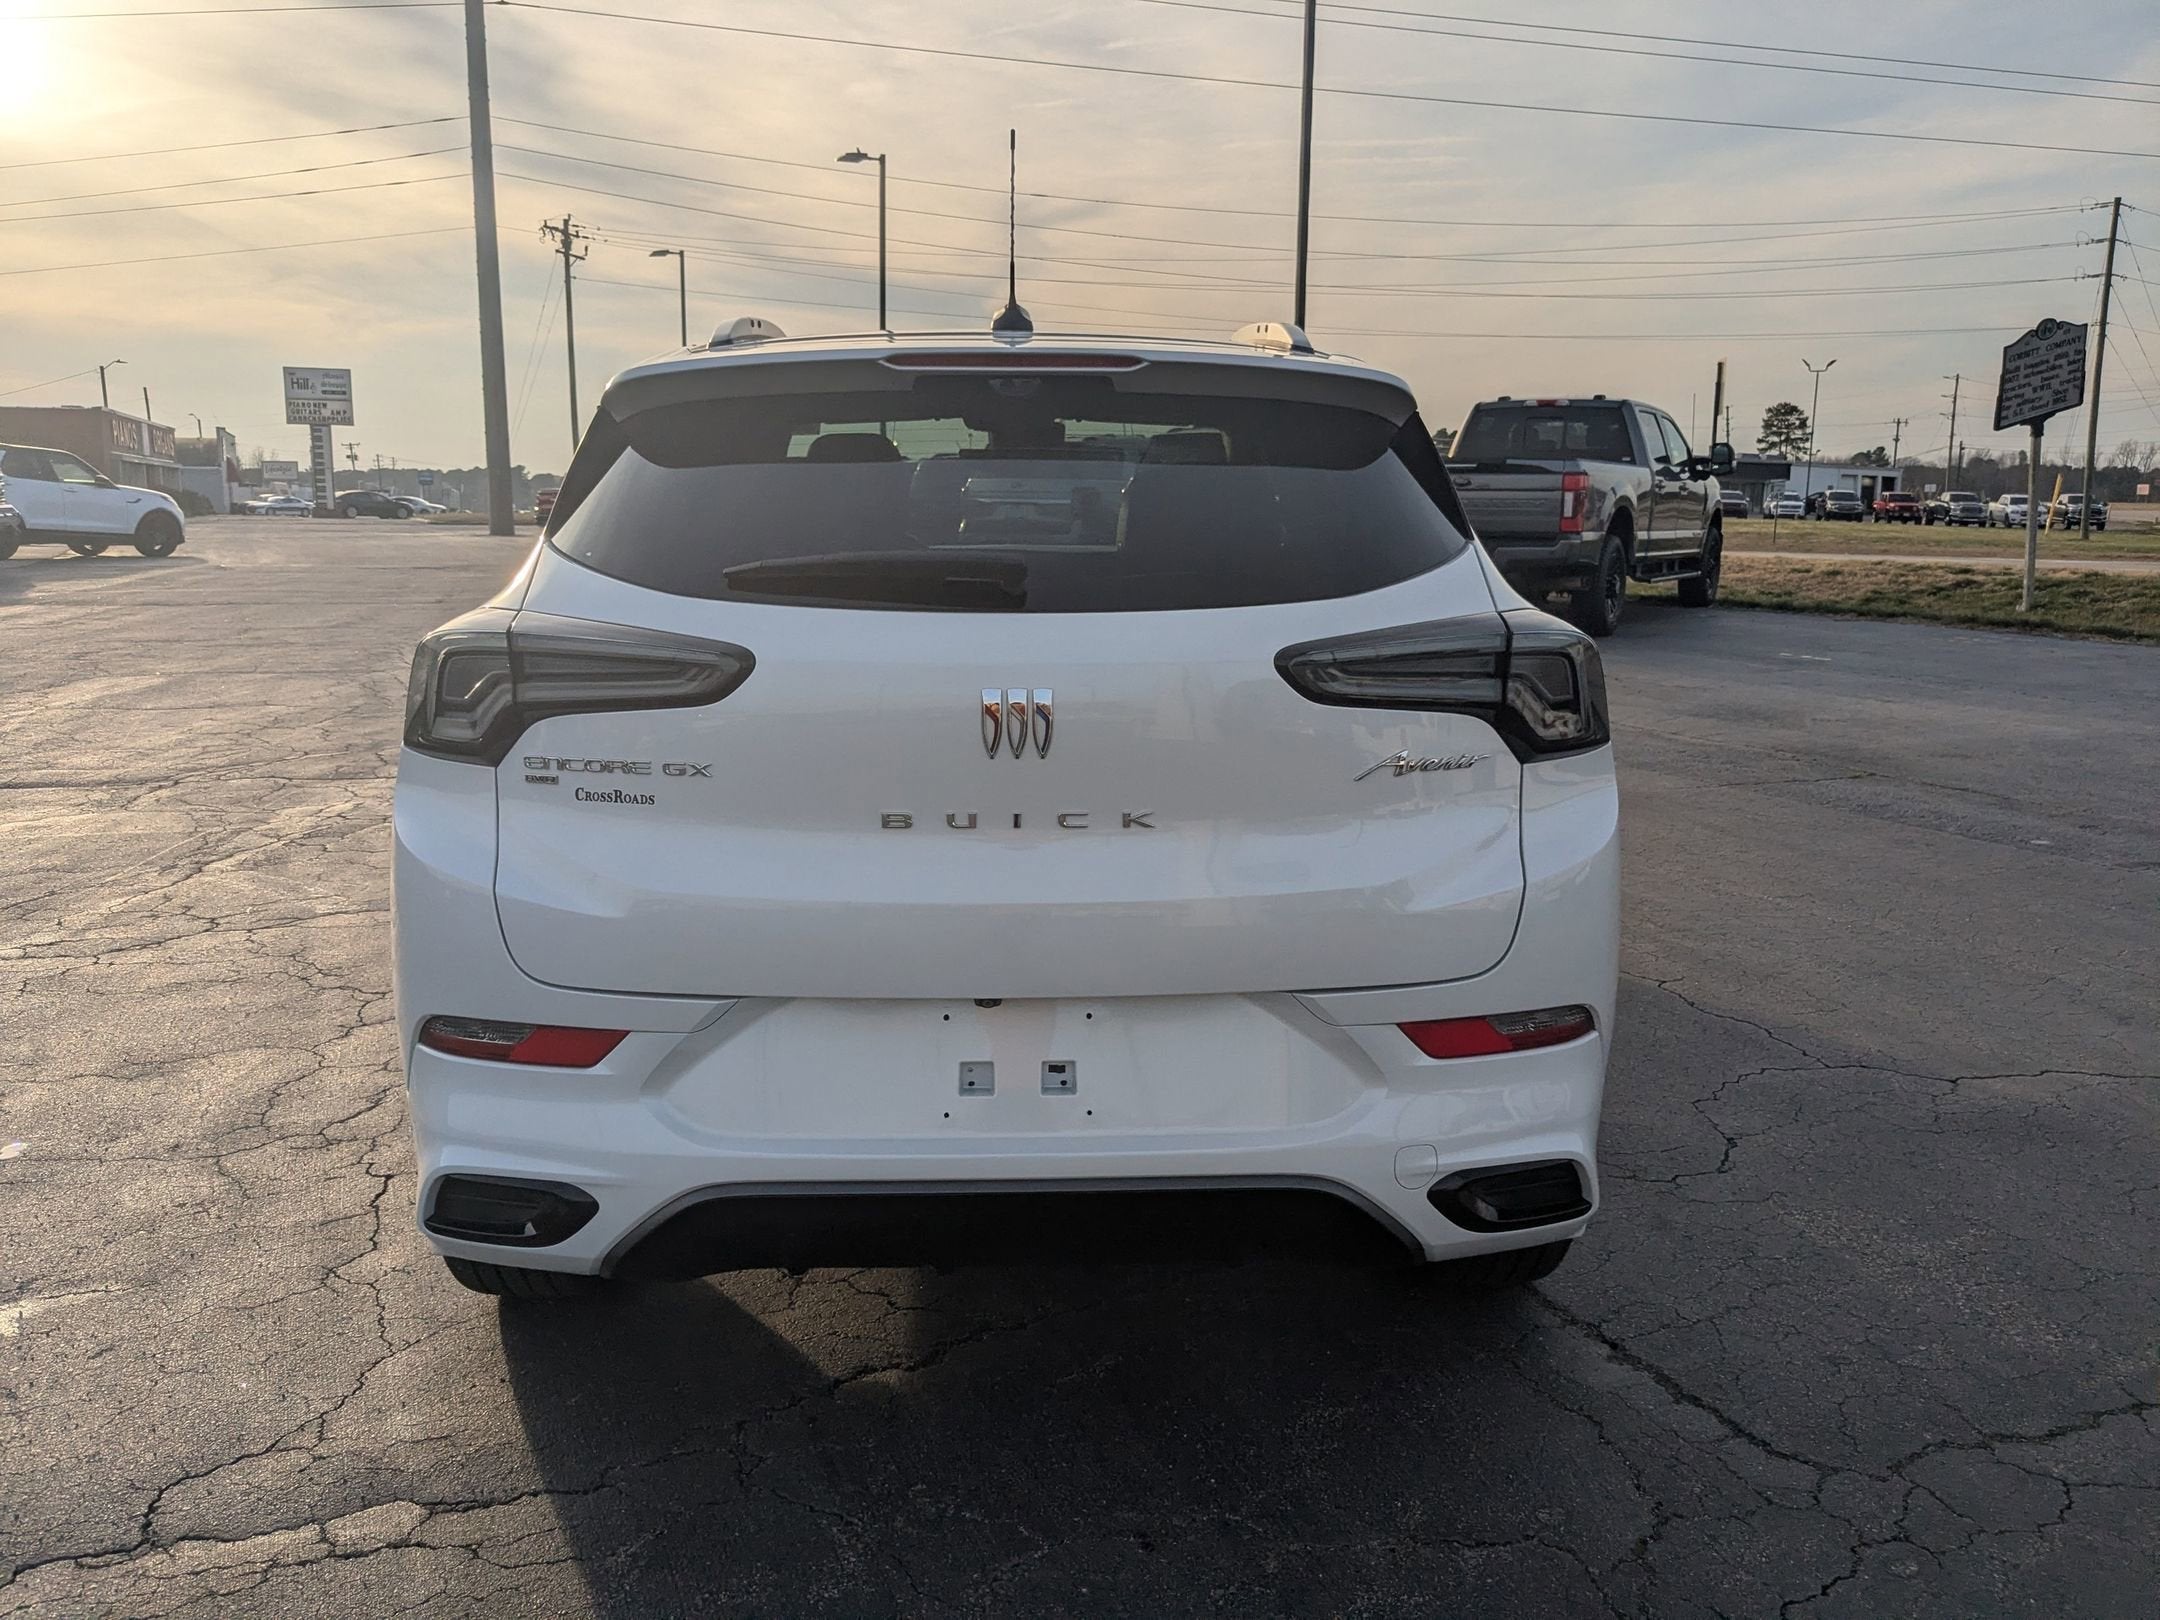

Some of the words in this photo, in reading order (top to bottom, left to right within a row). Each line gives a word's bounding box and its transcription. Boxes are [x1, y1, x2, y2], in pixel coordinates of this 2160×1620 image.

[112, 419, 138, 450] PIANOS
[663, 762, 713, 777] GX
[1353, 748, 1491, 781] Avenir
[881, 809, 1156, 829] BUICK
